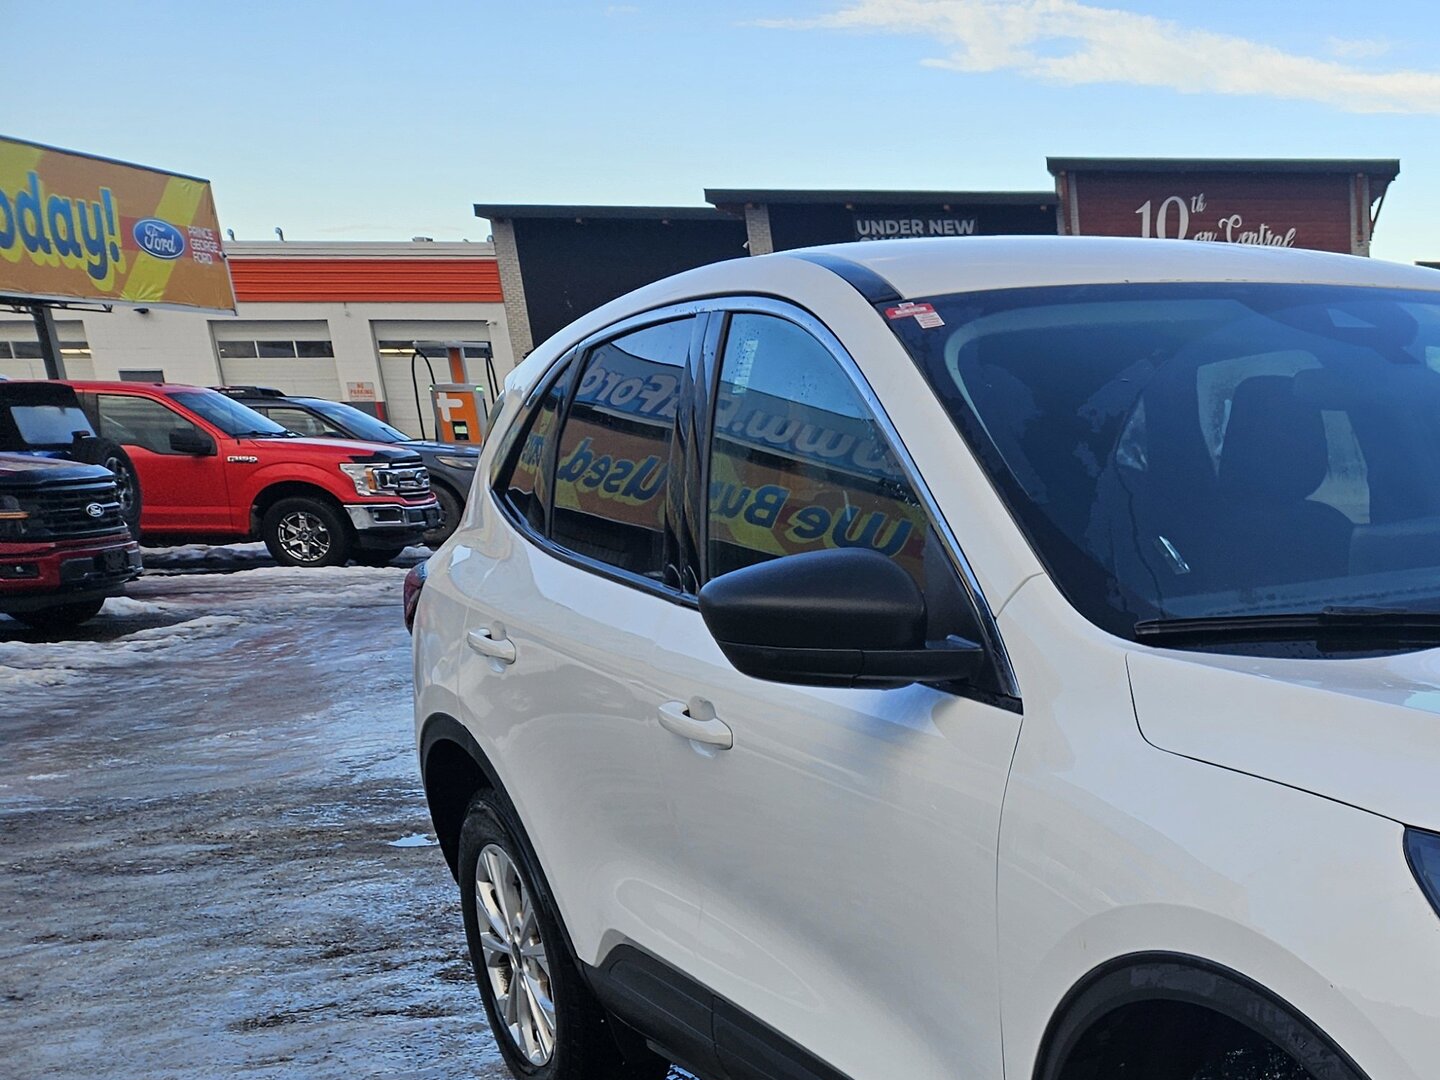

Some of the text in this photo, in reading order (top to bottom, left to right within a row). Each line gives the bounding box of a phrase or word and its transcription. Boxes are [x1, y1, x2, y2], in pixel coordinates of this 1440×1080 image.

[856, 219, 975, 236] UNDER NEW
[1218, 213, 1297, 249] Central
[190, 237, 220, 253] GEORGE
[192, 250, 213, 265] FORD
